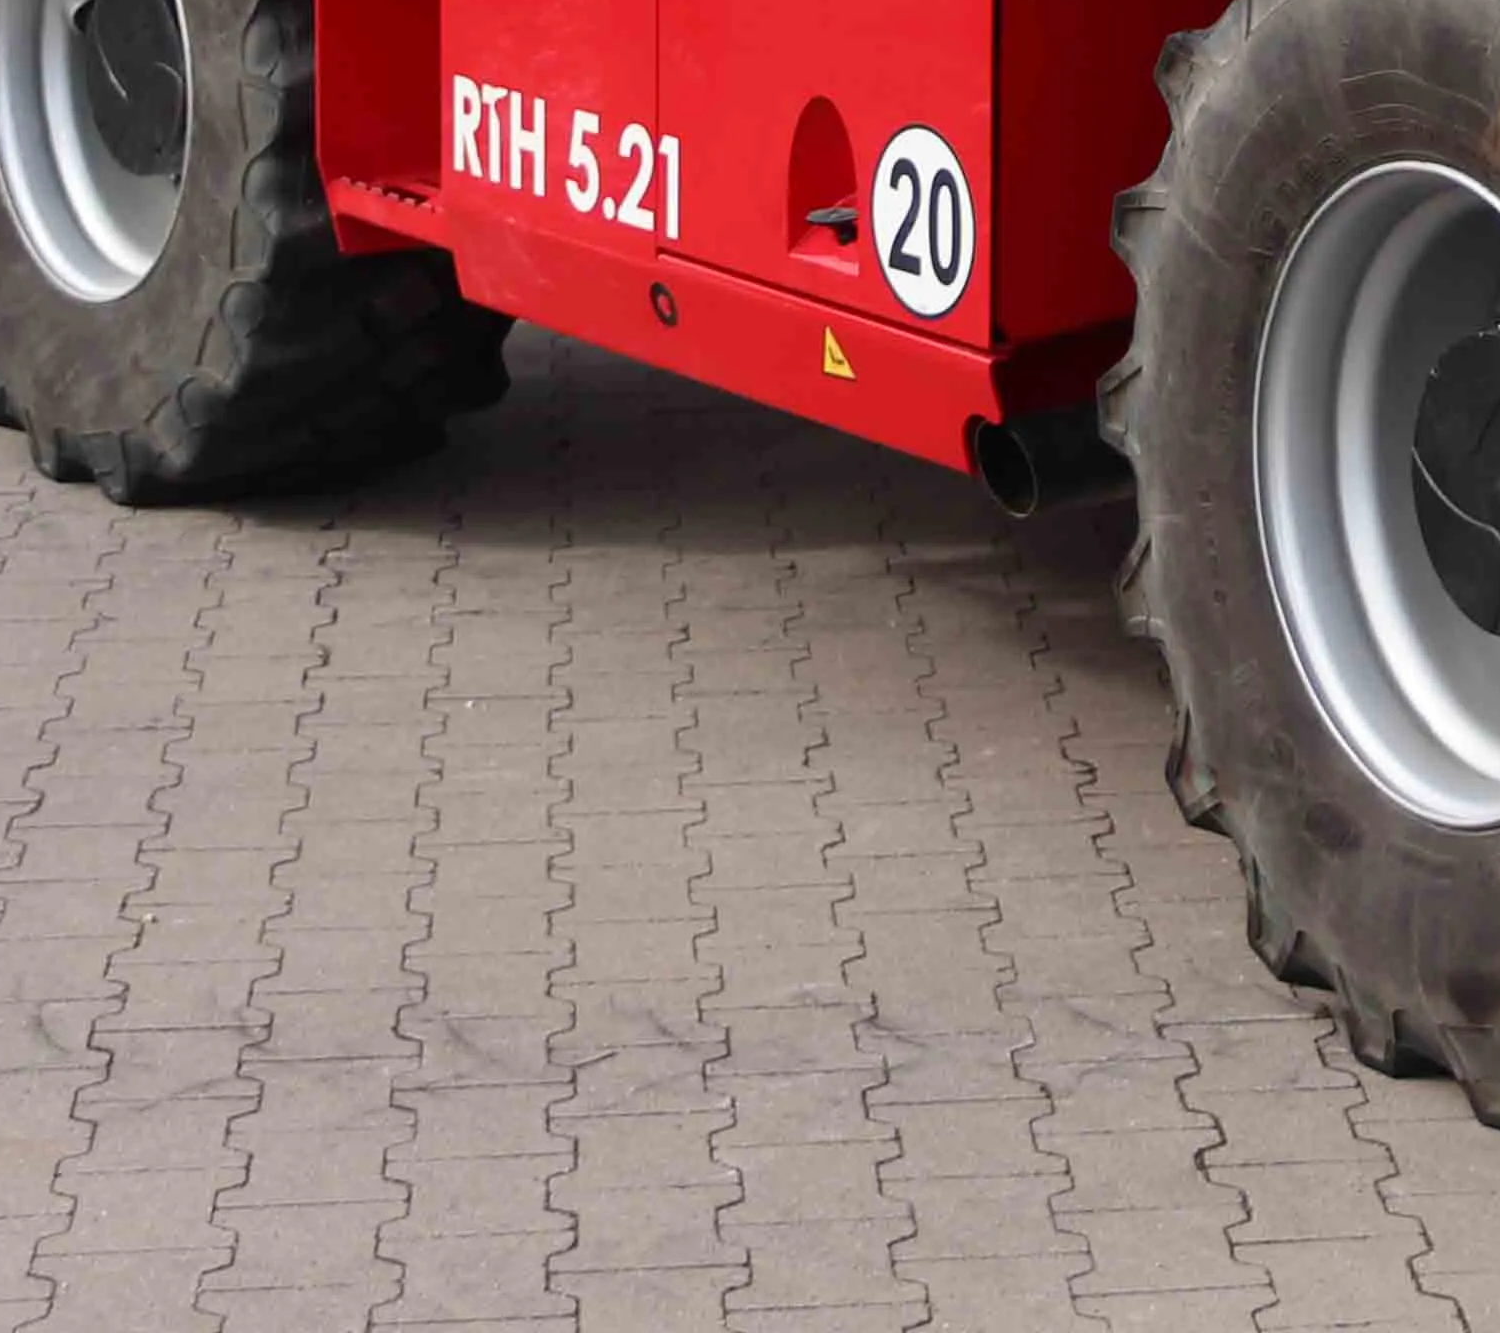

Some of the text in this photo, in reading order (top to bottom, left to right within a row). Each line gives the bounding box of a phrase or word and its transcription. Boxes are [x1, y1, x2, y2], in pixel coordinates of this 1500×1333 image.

[453, 74, 679, 241] RTH 5.21
[889, 156, 962, 286] 20
